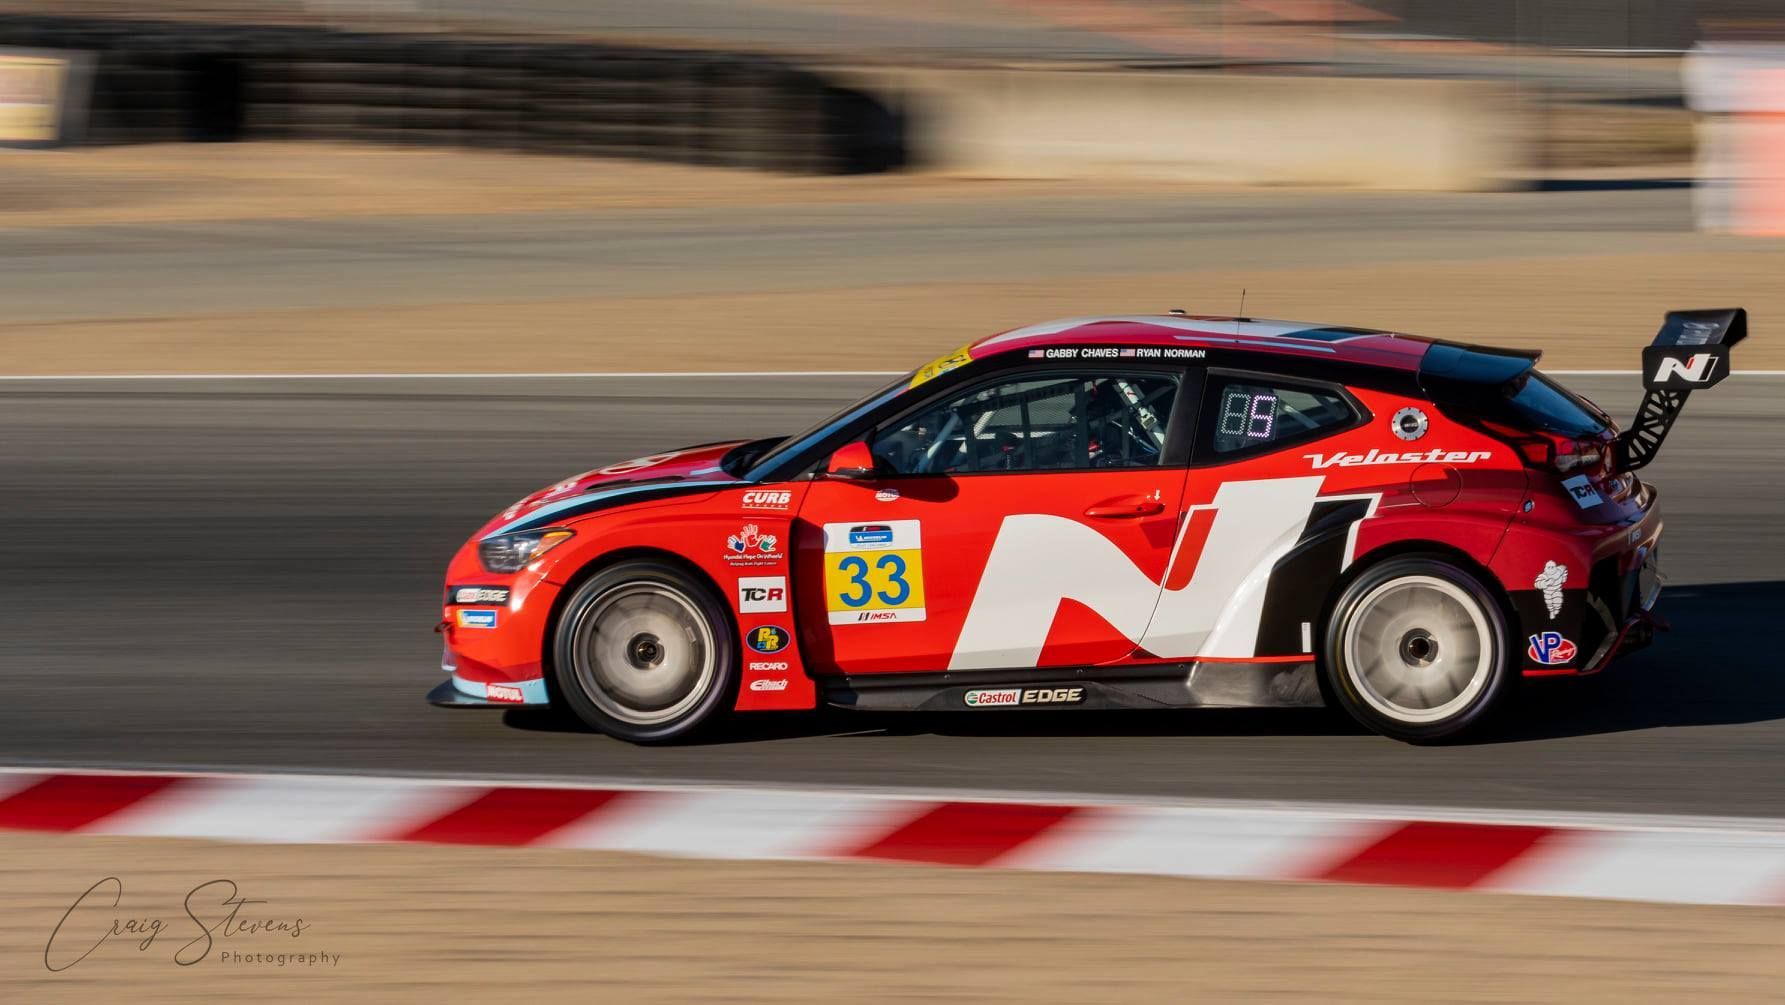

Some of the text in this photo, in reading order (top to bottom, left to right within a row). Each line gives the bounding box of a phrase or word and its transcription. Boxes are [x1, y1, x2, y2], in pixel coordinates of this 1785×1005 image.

[1046, 349, 1118, 358] GABBY CHAVES
[1136, 349, 1205, 358] RYAN NORMAN
[1303, 449, 1492, 469] Veloster
[742, 492, 791, 503] CURB
[838, 554, 911, 608] 33
[742, 588, 783, 602] TCR
[871, 612, 897, 620] IMSA
[1529, 631, 1562, 664] VP
[749, 662, 788, 671] RECARO
[979, 688, 1083, 704] Castrol EDGE
